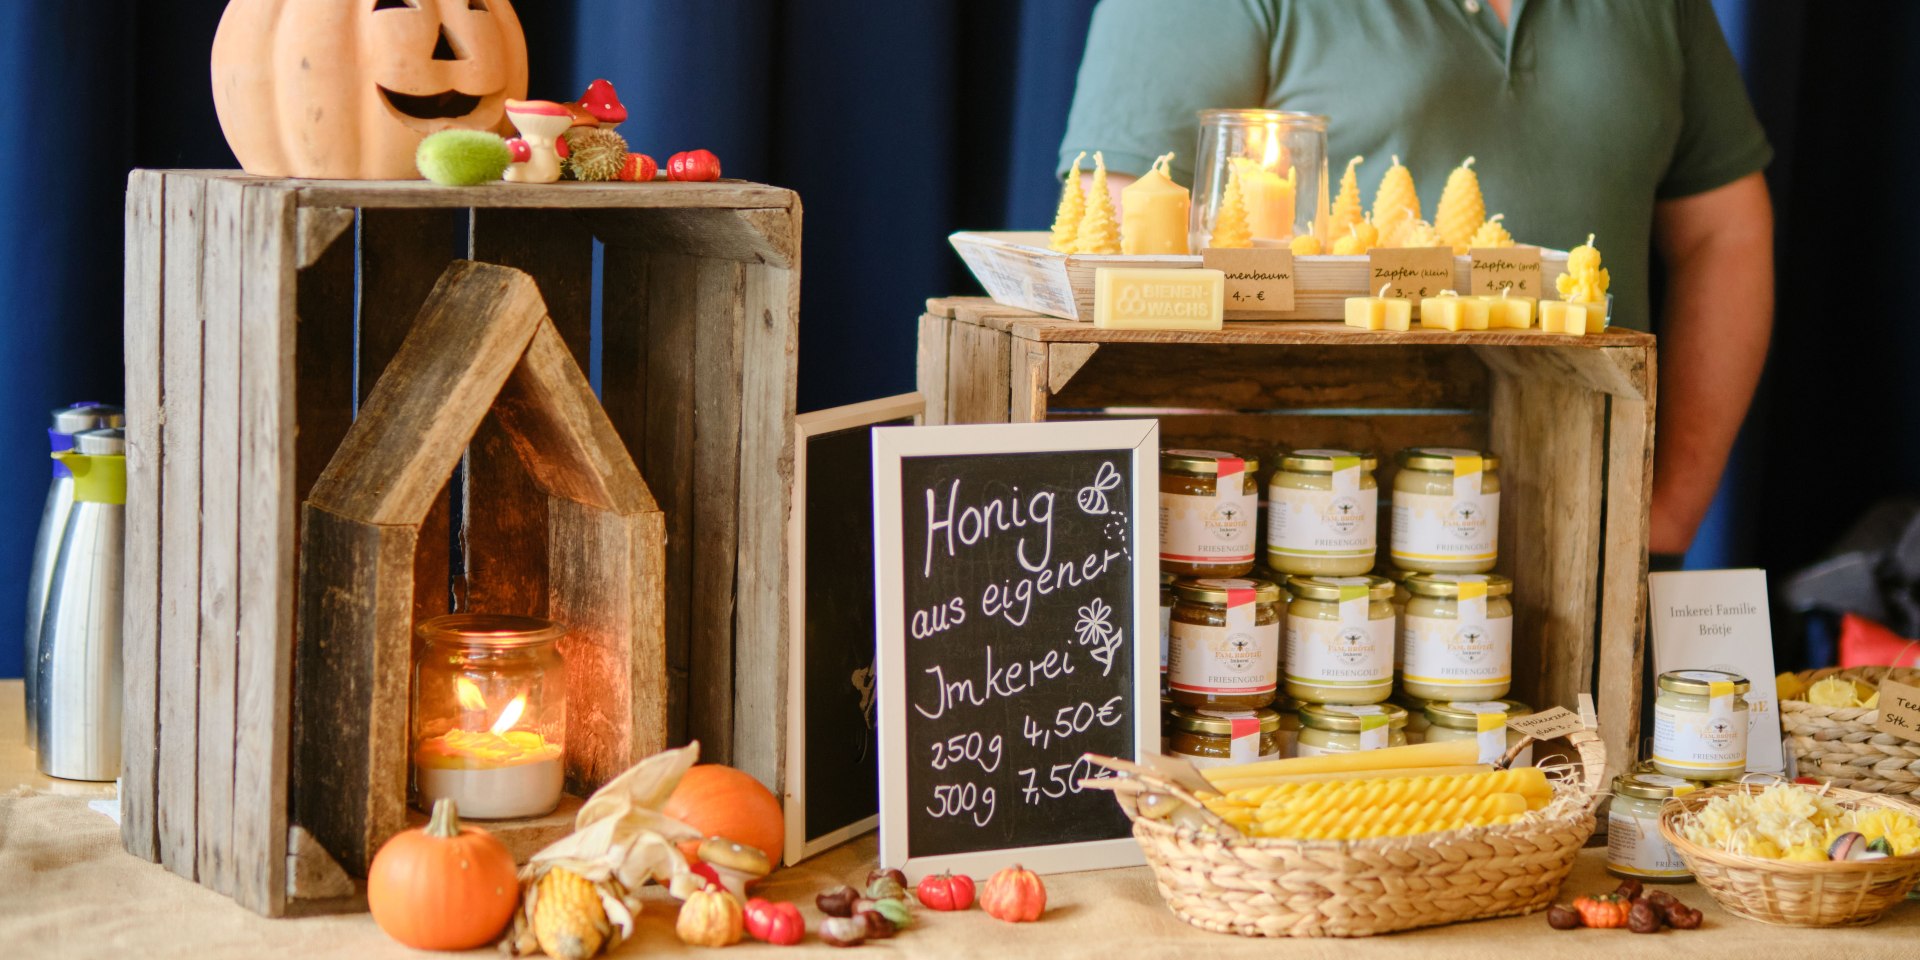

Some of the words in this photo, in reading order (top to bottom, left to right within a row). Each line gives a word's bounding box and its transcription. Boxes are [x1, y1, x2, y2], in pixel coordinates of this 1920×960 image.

[1374, 266, 1419, 280] Zapfen
[1420, 269, 1449, 278] (klein)
[1473, 259, 1517, 273] Zapfen
[1419, 287, 1428, 297] €
[1518, 280, 1527, 290] €
[1232, 290, 1252, 303] 4,-
[1256, 290, 1266, 301] €
[1149, 302, 1210, 317] WACHS
[924, 478, 1055, 578] Honig
[1198, 544, 1250, 553] FRIESENGOLD
[1314, 538, 1368, 547] FRIESENGOLD
[911, 596, 967, 639] aus
[982, 549, 1121, 627] eigener
[1670, 604, 1713, 618] Imkerei
[1716, 602, 1757, 616] Familie
[1699, 623, 1732, 637] Brötje
[1321, 668, 1379, 677] FRIESENGOLD
[1441, 667, 1498, 676] FRIESENGOLD
[1208, 675, 1265, 684] FRIESENGOLD
[1897, 697, 1920, 712] Tee
[931, 732, 1002, 773] 250g
[1023, 695, 1123, 750] 4,50€
[1693, 752, 1741, 760] FRIESENGOLD
[926, 782, 996, 827] 500g
